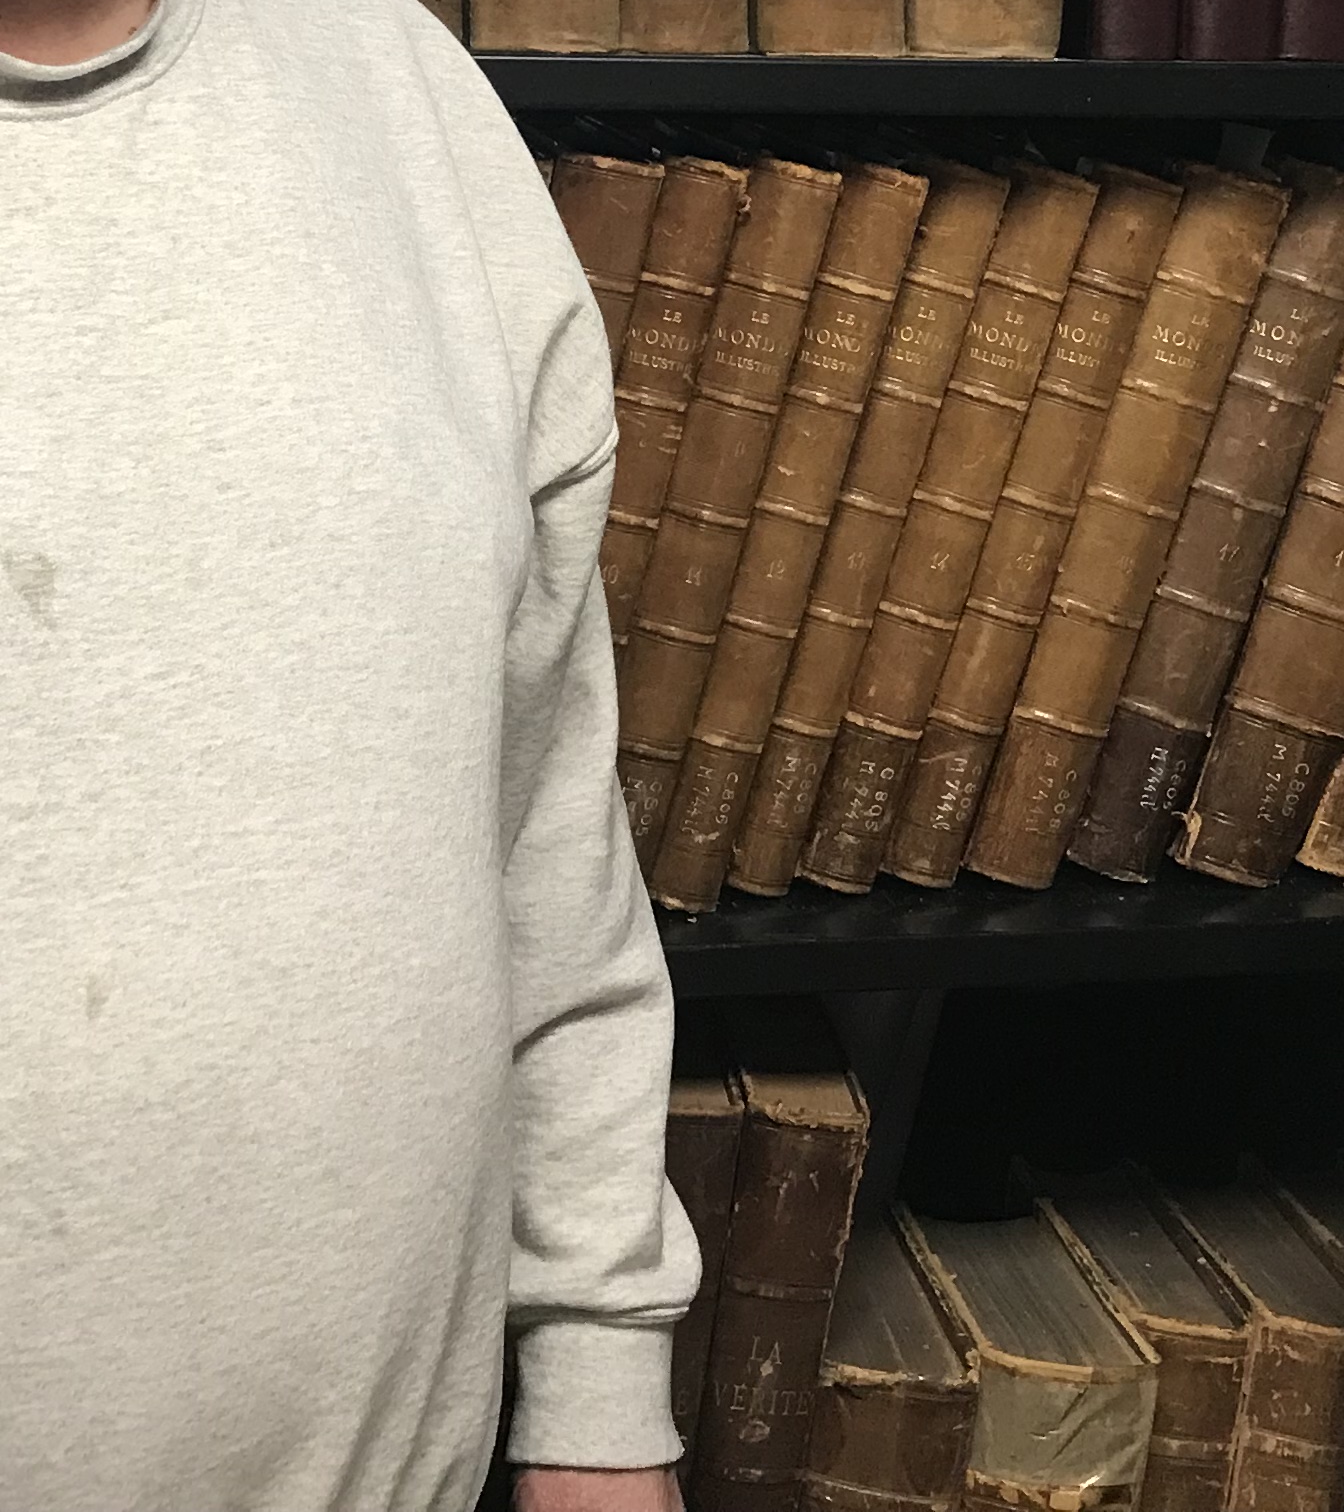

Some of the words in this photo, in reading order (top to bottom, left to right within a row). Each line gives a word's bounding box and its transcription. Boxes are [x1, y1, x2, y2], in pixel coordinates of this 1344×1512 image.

[662, 309, 683, 323] LE
[751, 310, 771, 325] LE
[836, 311, 856, 326] LE
[917, 306, 937, 321] LE
[1004, 310, 1025, 325] LE
[1091, 310, 1111, 324] LE
[749, 1335, 783, 1366] LA
